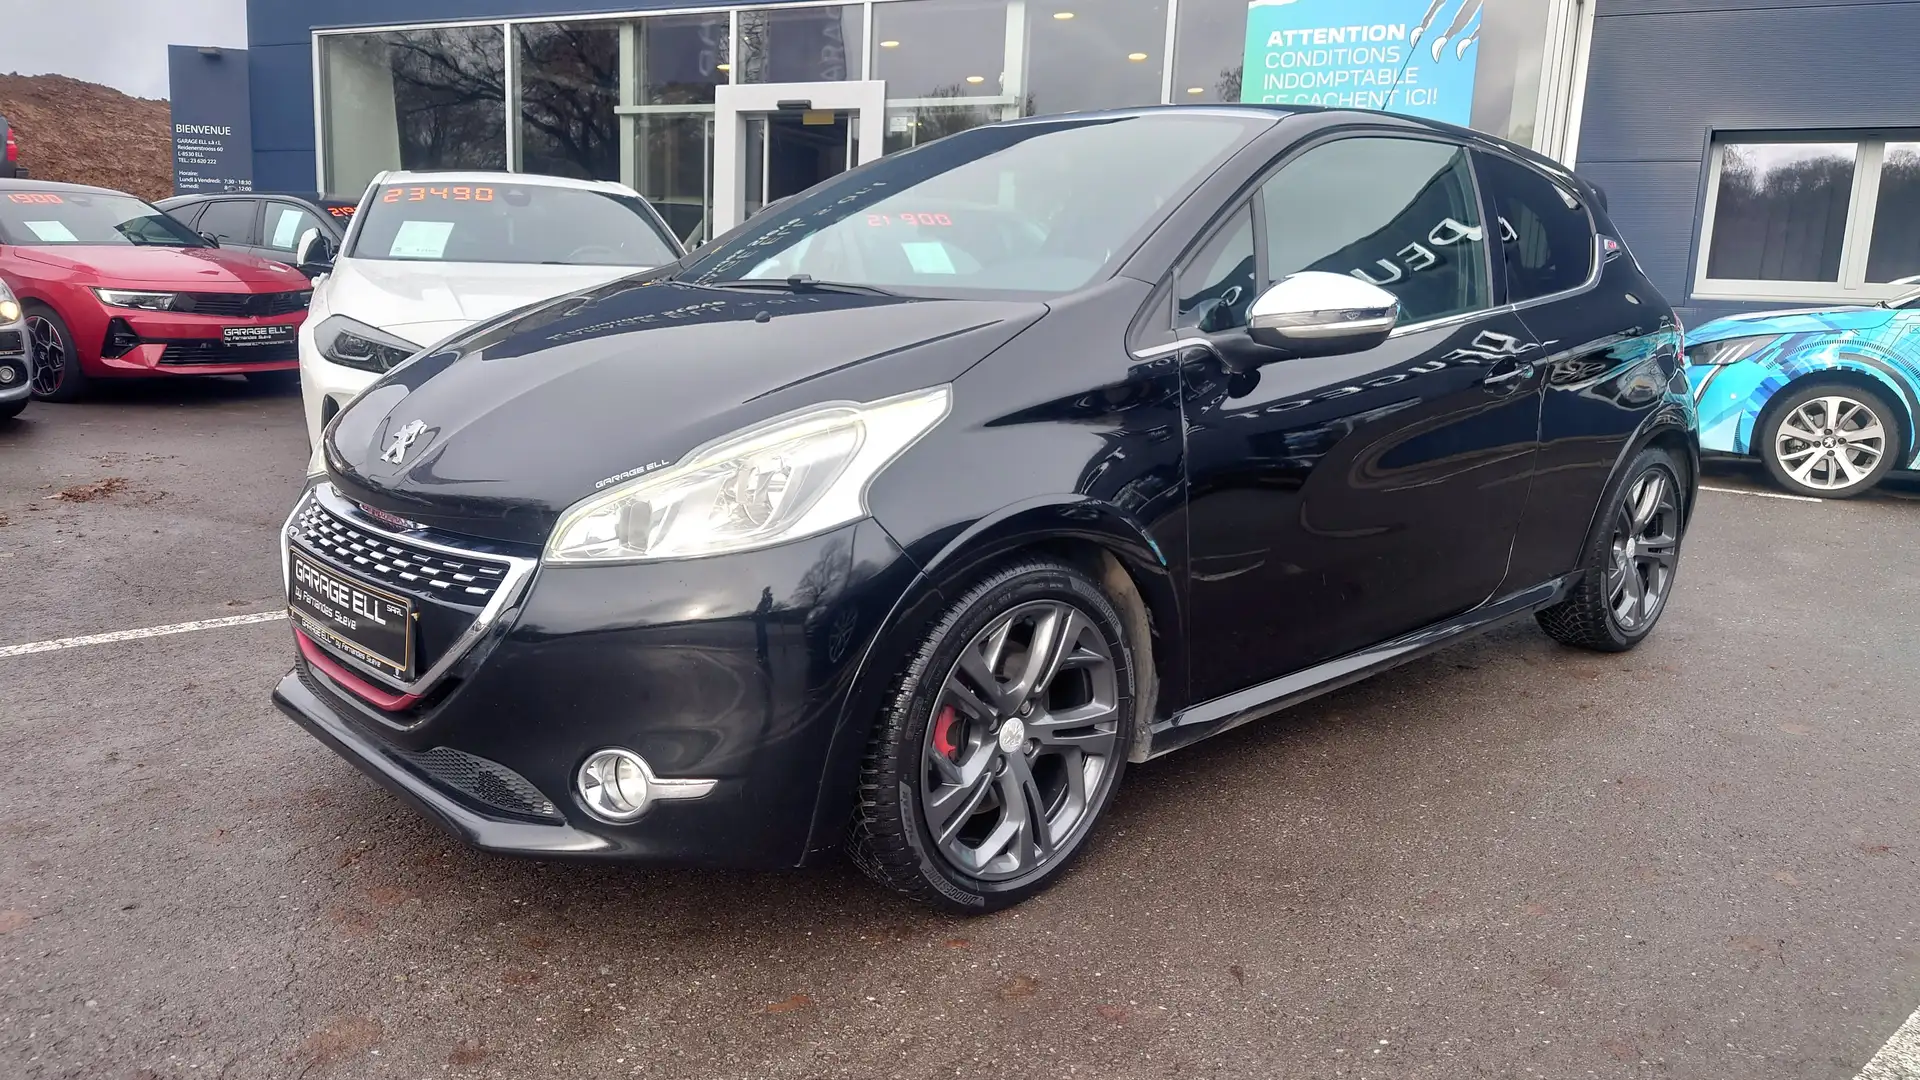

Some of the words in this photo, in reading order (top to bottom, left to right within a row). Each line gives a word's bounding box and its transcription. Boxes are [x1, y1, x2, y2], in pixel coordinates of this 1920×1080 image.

[1266, 23, 1406, 48] ATTENTION
[1265, 46, 1400, 69] CONDITIONS
[1263, 67, 1419, 91] INDOMPTABLE
[1294, 89, 1400, 109] CACHENT
[1405, 88, 1438, 105] ICI!
[175, 124, 231, 136] BIENVENUE
[900, 212, 952, 226] 900
[224, 328, 267, 336] GARAGE
[268, 326, 286, 335] ELL
[595, 466, 645, 488] GARAGE
[646, 459, 670, 471] ELL
[295, 559, 350, 609] GARAGE
[352, 590, 387, 626] ELL
[386, 603, 403, 617] SARL
[294, 585, 302, 601] by
[302, 590, 333, 618] Fernandes
[334, 610, 357, 630] Steve
[301, 618, 322, 637] GARAGE
[321, 631, 332, 644] ELL
[335, 640, 341, 649] by
[341, 642, 366, 660] Fernandes
[366, 653, 381, 668] Steve
